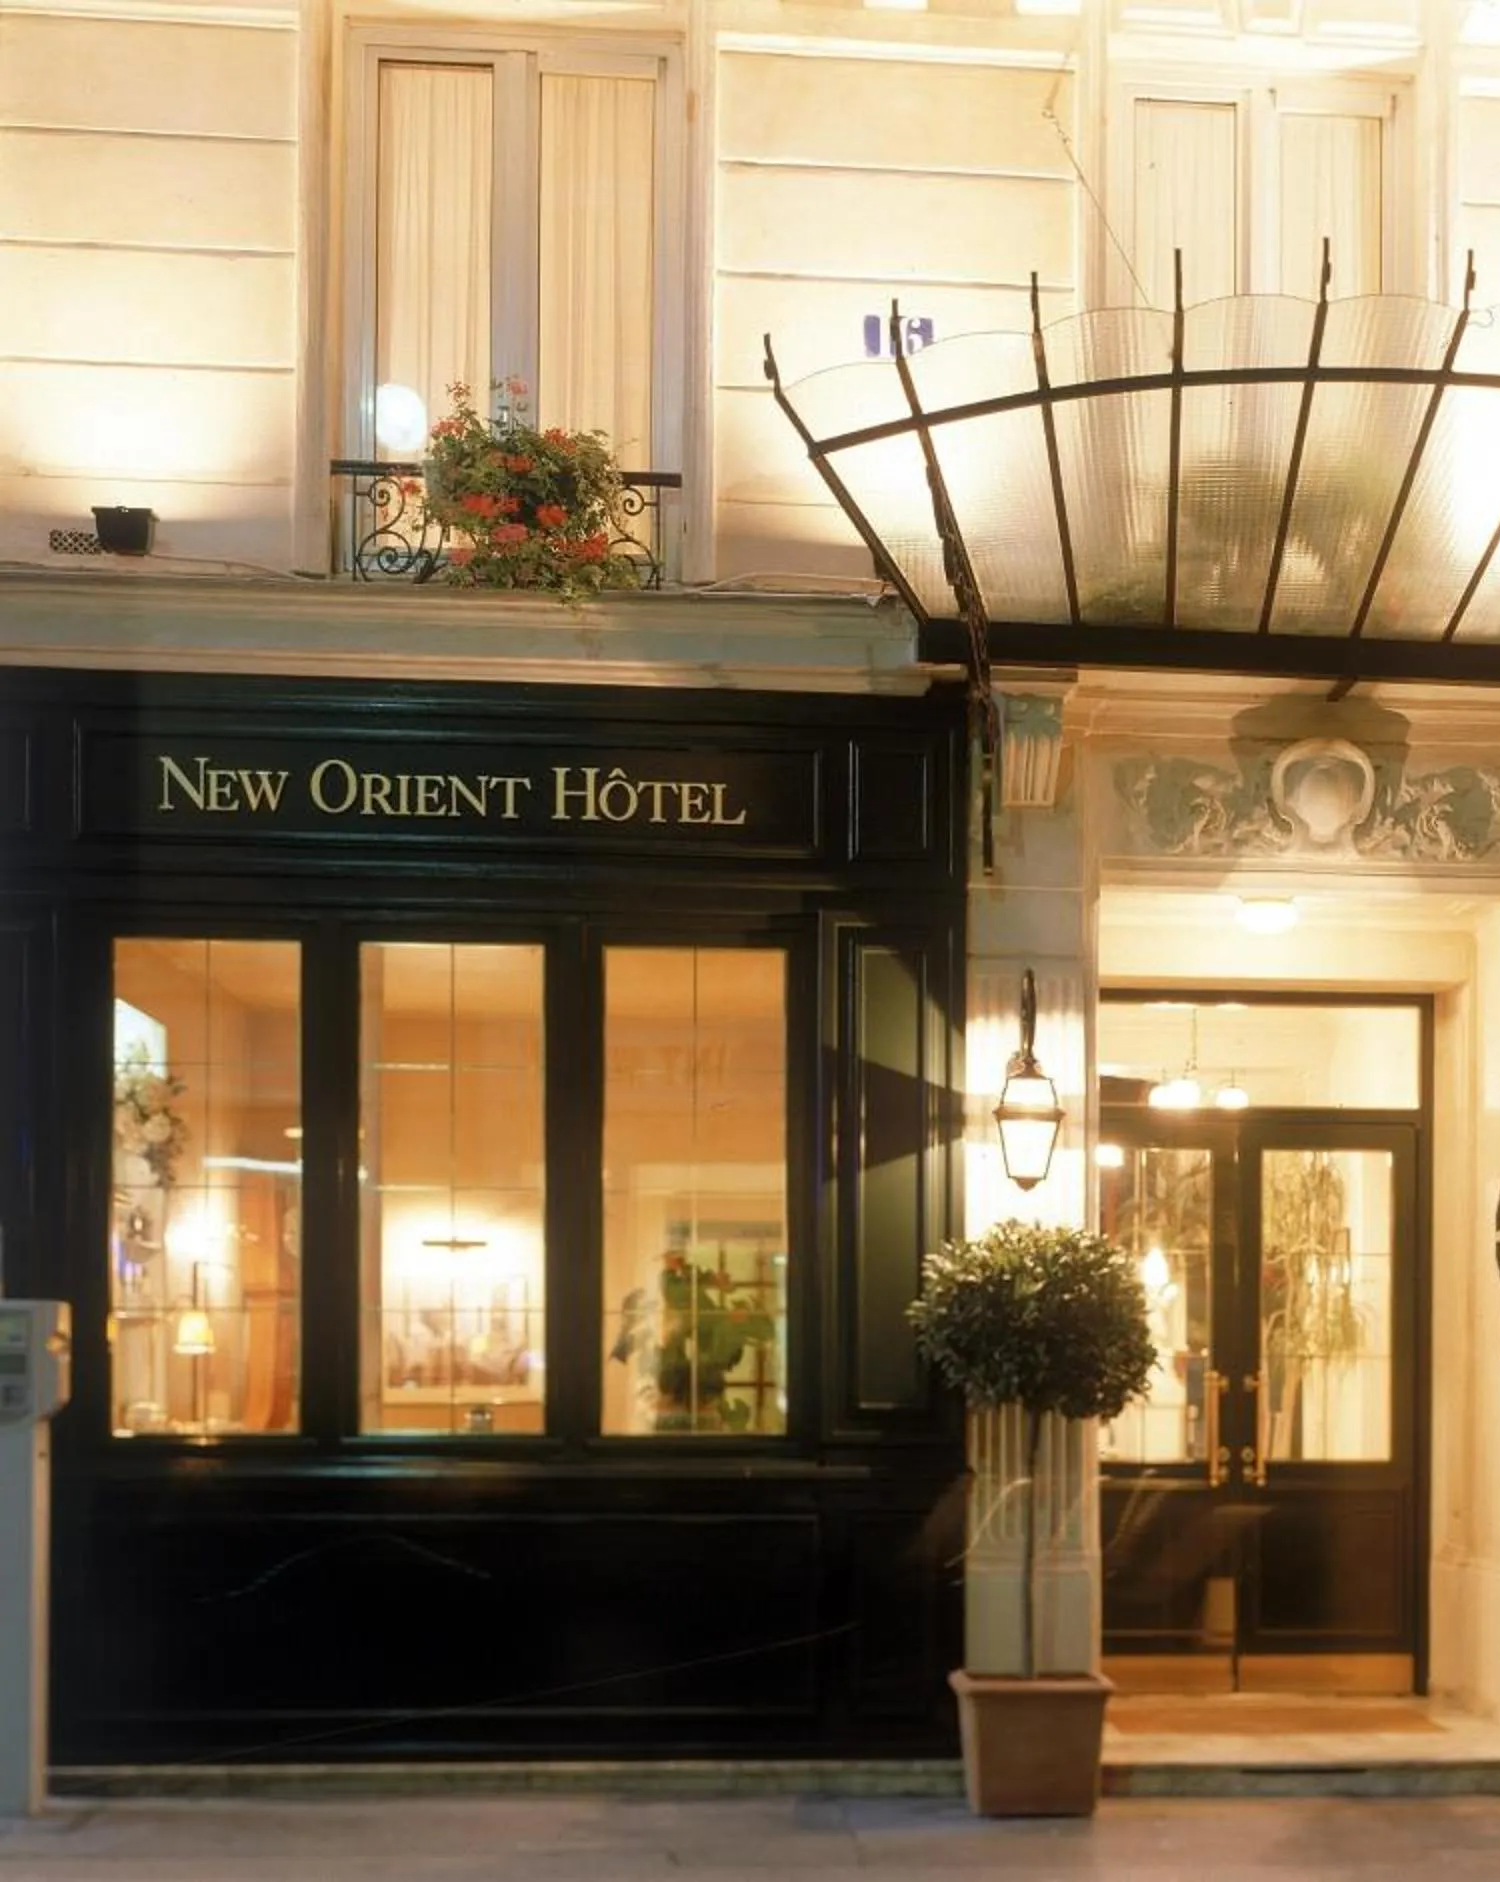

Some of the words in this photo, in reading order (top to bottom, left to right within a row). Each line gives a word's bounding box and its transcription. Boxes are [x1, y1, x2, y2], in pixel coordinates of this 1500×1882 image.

[158, 756, 289, 812] NEW
[309, 759, 532, 819] ORIENT
[551, 767, 747, 826] HÔTEL
